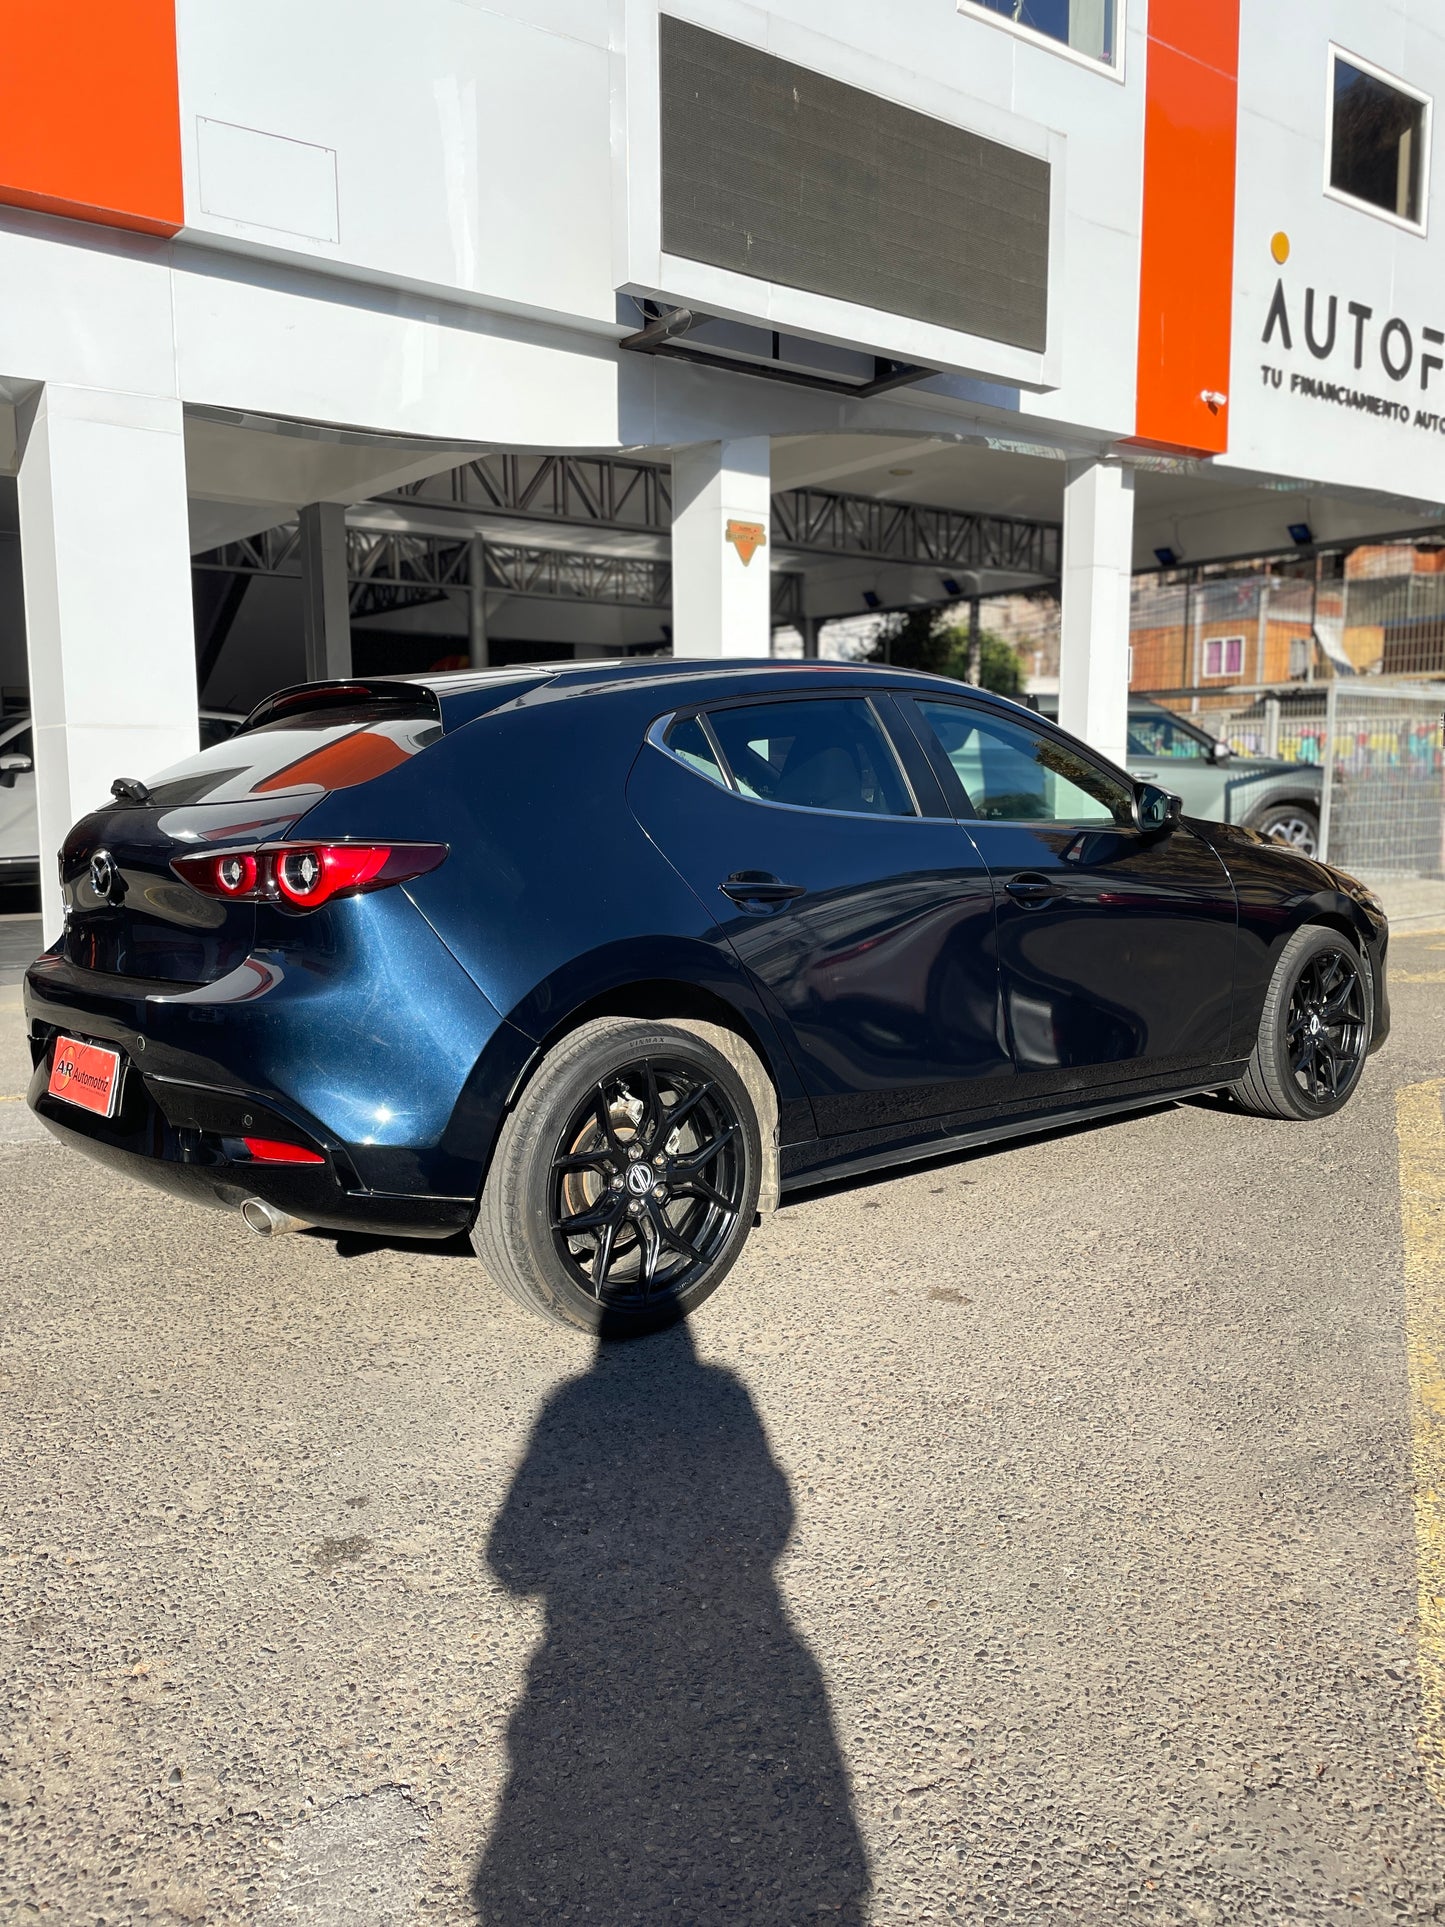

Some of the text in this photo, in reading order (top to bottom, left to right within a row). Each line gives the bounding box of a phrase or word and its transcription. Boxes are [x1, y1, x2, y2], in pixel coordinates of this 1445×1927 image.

[1261, 365, 1283, 389] TU
[1291, 373, 1410, 423] FINANCIAMENTO
[629, 1037, 665, 1047] VINMAX
[72, 1067, 109, 1092] Automotriz
